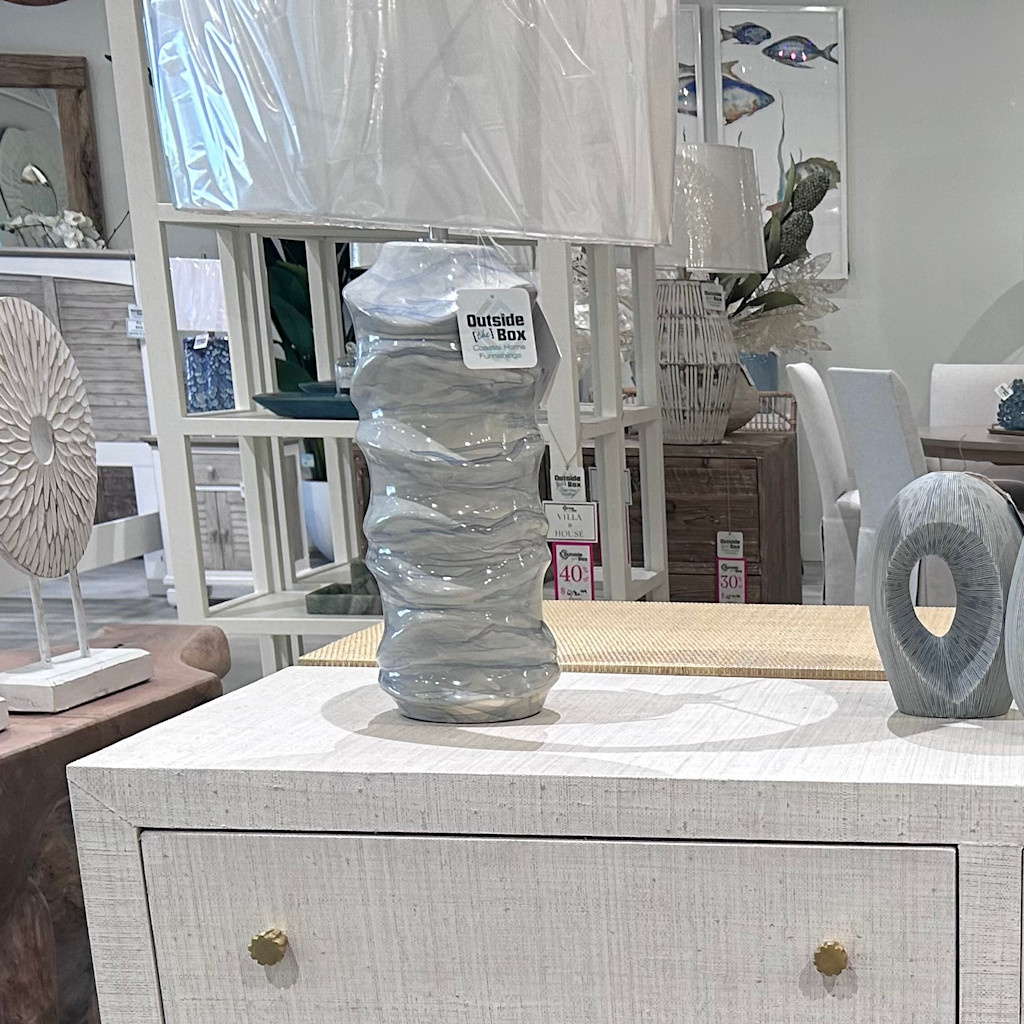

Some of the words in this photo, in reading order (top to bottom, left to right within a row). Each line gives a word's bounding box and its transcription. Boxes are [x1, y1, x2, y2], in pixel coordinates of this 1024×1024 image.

[466, 313, 525, 328] Outside
[496, 328, 527, 342] Box
[557, 513, 582, 521] VILLA
[555, 530, 585, 538] HOUSE
[559, 564, 583, 583] 40
[721, 575, 738, 589] 30
